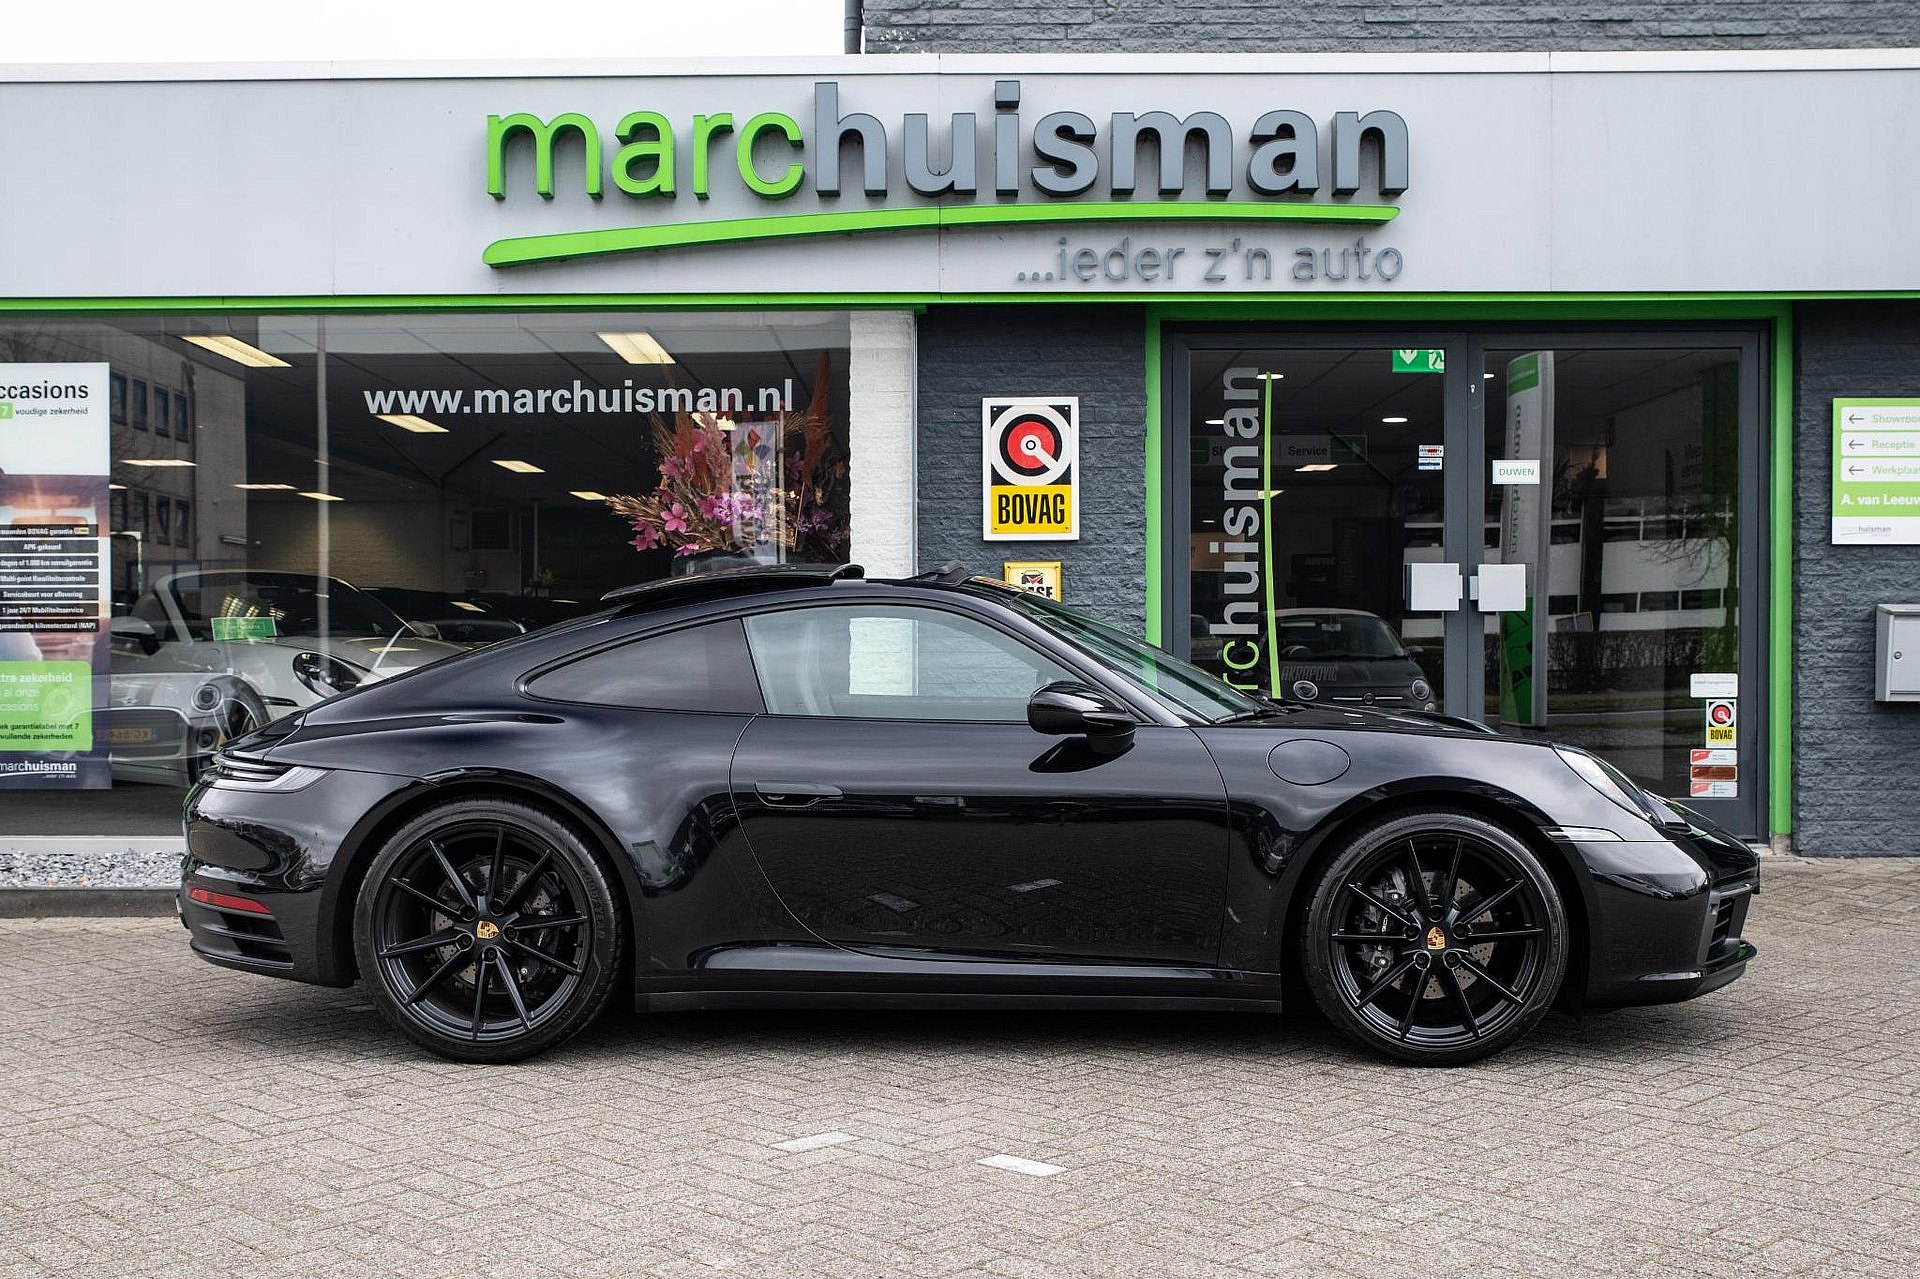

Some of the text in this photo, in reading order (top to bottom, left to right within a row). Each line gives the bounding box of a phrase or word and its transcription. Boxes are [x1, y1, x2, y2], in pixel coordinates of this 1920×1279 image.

[486, 80, 1410, 200] marchuisman
[1204, 237, 1272, 281] z'n
[1292, 237, 1403, 281] auto
[0, 380, 89, 400] ccasions
[363, 379, 793, 415] www.marchuisman.nl
[50, 406, 89, 416] zekerheid
[1287, 445, 1328, 456] Service
[1872, 438, 1916, 451] Receptie
[1499, 467, 1535, 477] DUWEN
[1840, 494, 1855, 505] A.
[1857, 496, 1880, 505] van
[997, 493, 1065, 526] BOVAG
[1710, 729, 1733, 740] BOVAG
